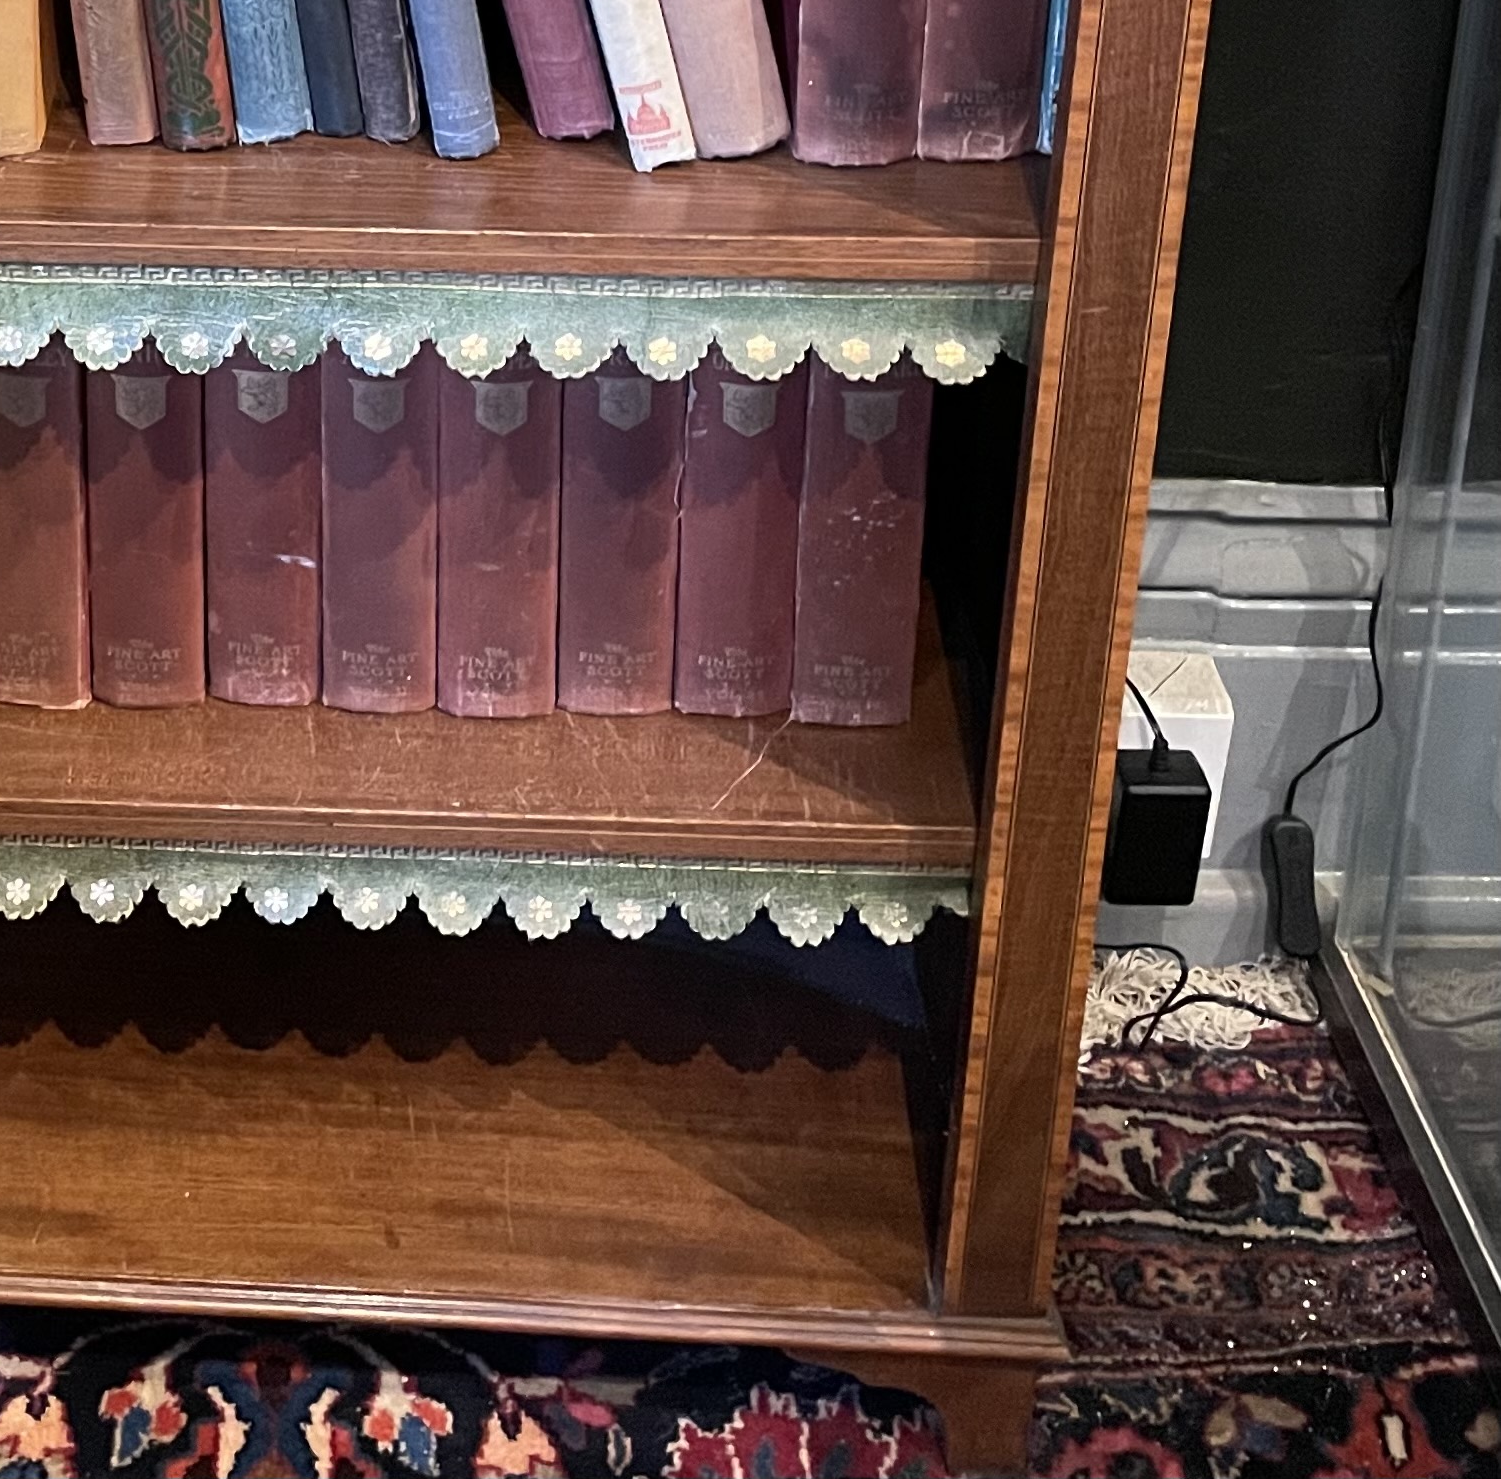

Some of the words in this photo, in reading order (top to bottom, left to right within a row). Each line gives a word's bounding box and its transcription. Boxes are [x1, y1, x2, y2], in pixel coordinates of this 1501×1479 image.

[944, 90, 991, 105] FINE
[107, 645, 146, 661] FINE
[148, 647, 183, 661] ART
[270, 643, 302, 657] ART
[341, 649, 379, 665] FINE
[384, 651, 420, 666] ART
[578, 650, 619, 666] FINE
[623, 650, 659, 666] ART
[113, 659, 173, 673] SCOTT
[458, 653, 498, 670] FINE
[698, 653, 736, 671] FINE
[347, 663, 409, 679] SCOTT
